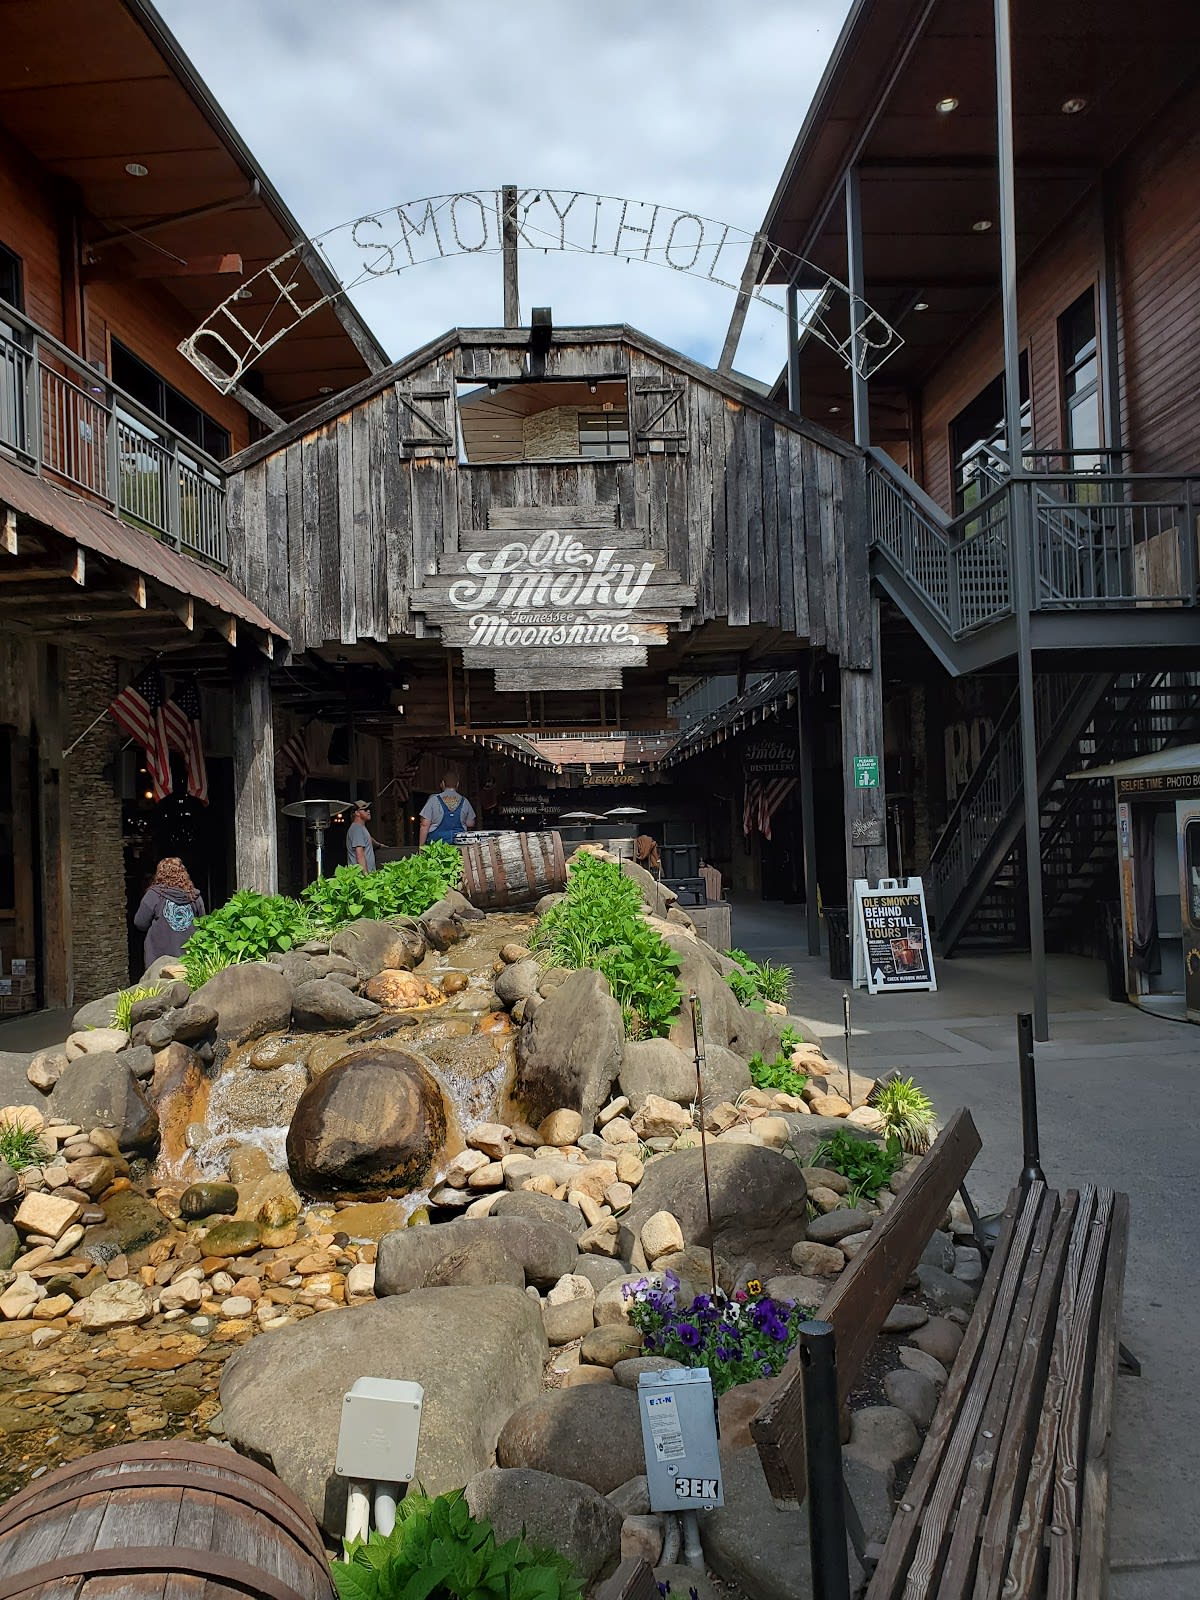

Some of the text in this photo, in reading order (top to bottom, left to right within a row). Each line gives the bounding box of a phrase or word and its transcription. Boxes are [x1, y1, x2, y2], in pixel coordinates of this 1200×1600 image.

[188, 190, 893, 384] OLE SMOKY HOLLER
[527, 530, 593, 567] Ole
[449, 542, 656, 619] Smoky
[511, 611, 575, 624] Tennessee
[468, 613, 640, 646] Moonshine
[744, 743, 796, 763] Smoky
[750, 763, 794, 772] DISTILLERY
[582, 774, 635, 785] ELEVATOR
[1120, 779, 1145, 791] SELFIE
[1146, 777, 1164, 789] TIME
[1166, 775, 1192, 788] PHOTO
[852, 817, 878, 839] SMOKING
[863, 895, 919, 908] OLE SMOKY'S
[865, 906, 902, 918] BEHIND
[866, 916, 916, 929] THE STILL
[867, 927, 902, 939] TOURS
[675, 1478, 718, 1498] 3EK
